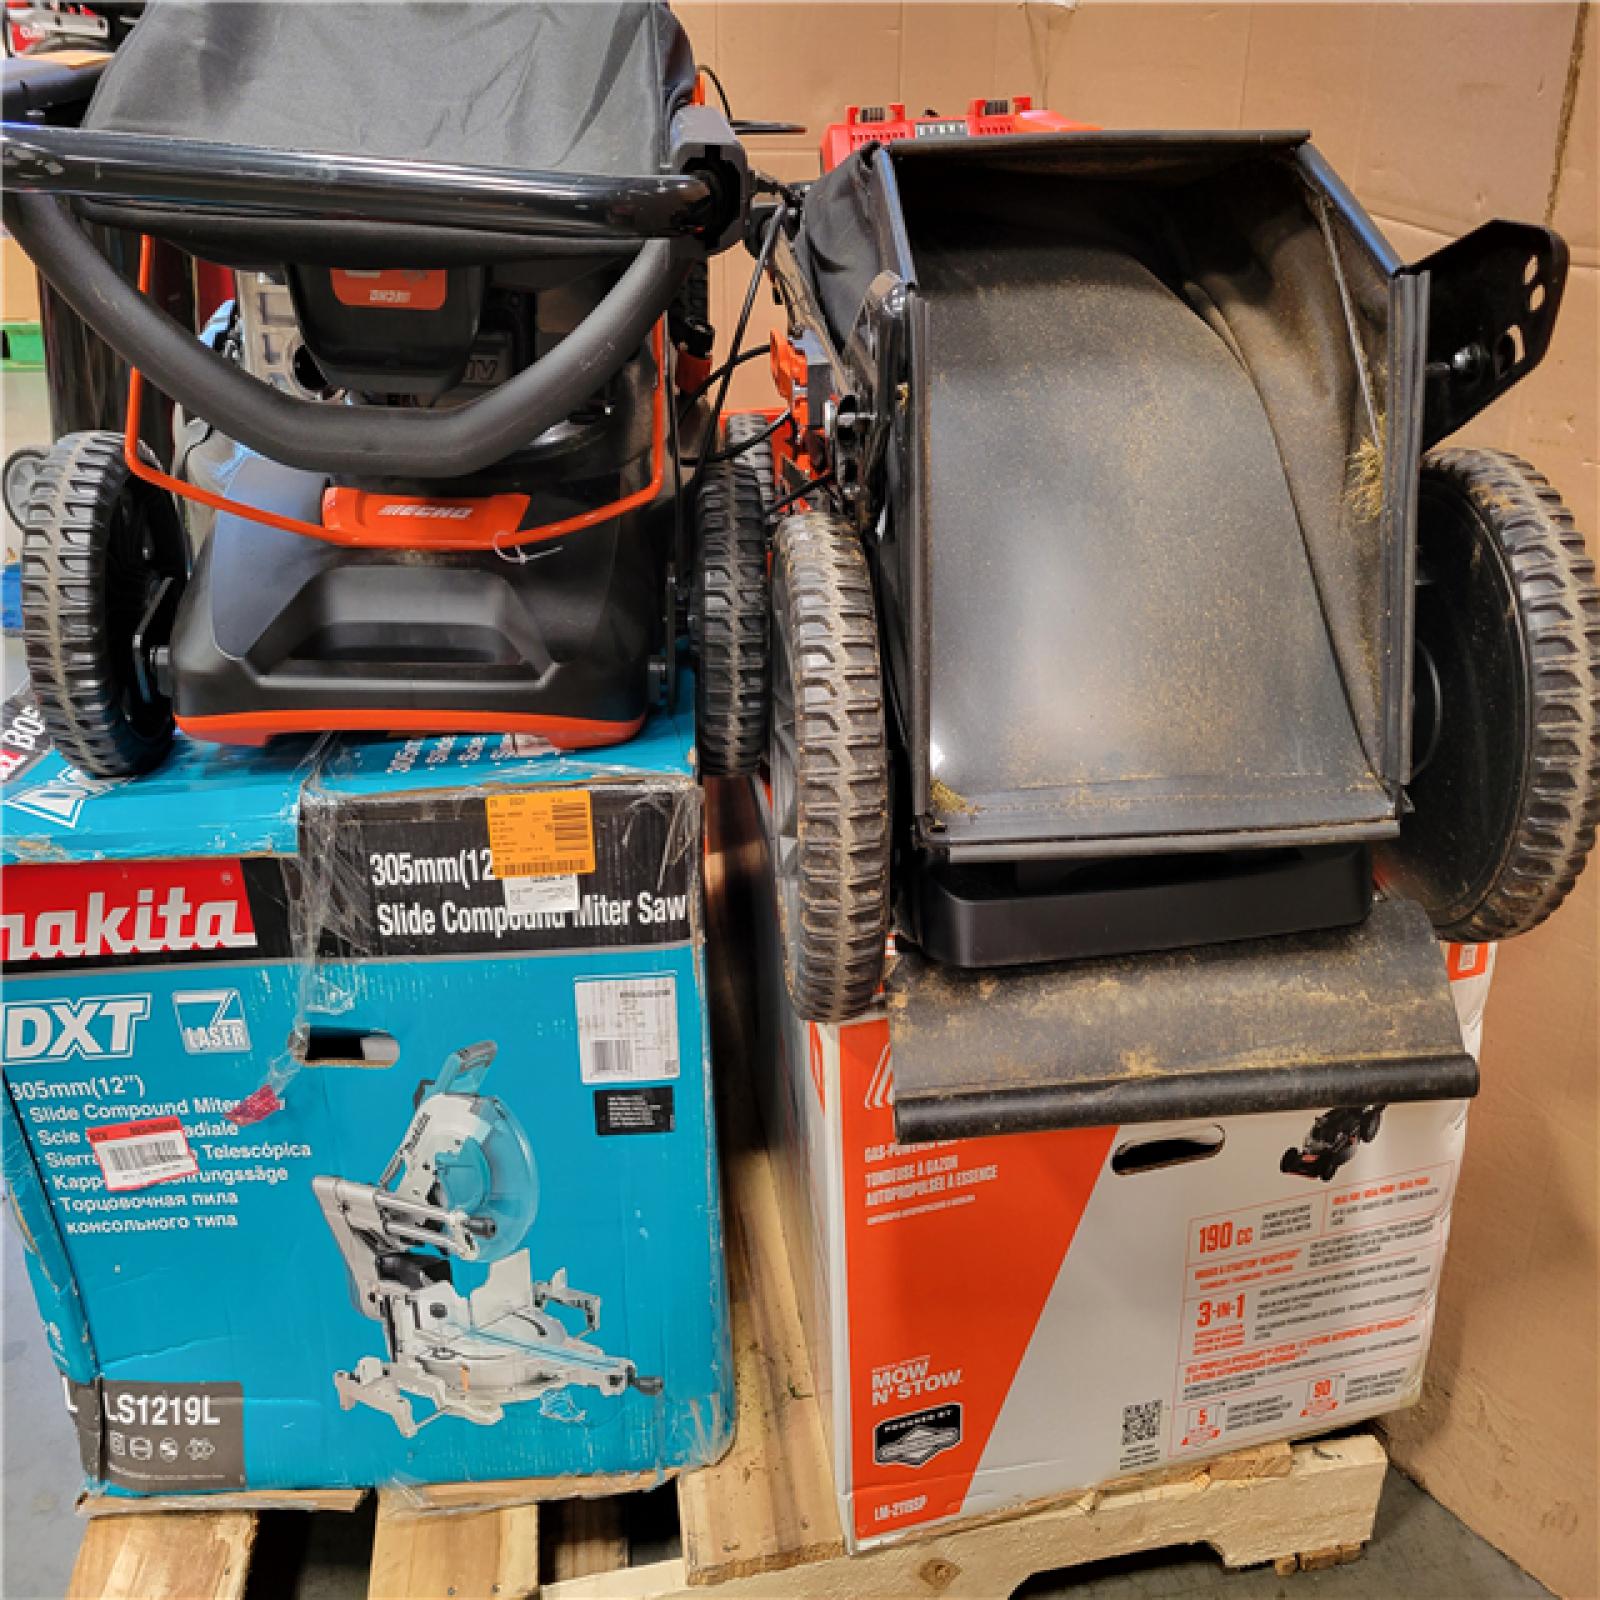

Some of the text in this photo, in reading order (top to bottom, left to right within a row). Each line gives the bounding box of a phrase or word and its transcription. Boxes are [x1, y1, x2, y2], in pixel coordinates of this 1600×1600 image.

[370, 849, 494, 890] 305mm(12
[377, 902, 436, 936] Slide
[639, 890, 687, 924] Saw
[4, 997, 247, 1061] DXT LASER
[30, 1097, 241, 1122] Slide Compound Miter
[37, 1128, 81, 1146] Scie
[183, 1120, 239, 1138] adiale
[202, 1142, 313, 1161] Telescópica
[956, 1164, 998, 1187] ESSENCE
[61, 1192, 238, 1214] Торцовочная пила
[66, 1214, 239, 1235] консольного типа
[1199, 1219, 1234, 1254] 190
[1196, 1292, 1246, 1328] 3-IN-1
[871, 1358, 931, 1391] MOW
[103, 1391, 221, 1426] LS1219L
[1198, 1407, 1208, 1426] 5
